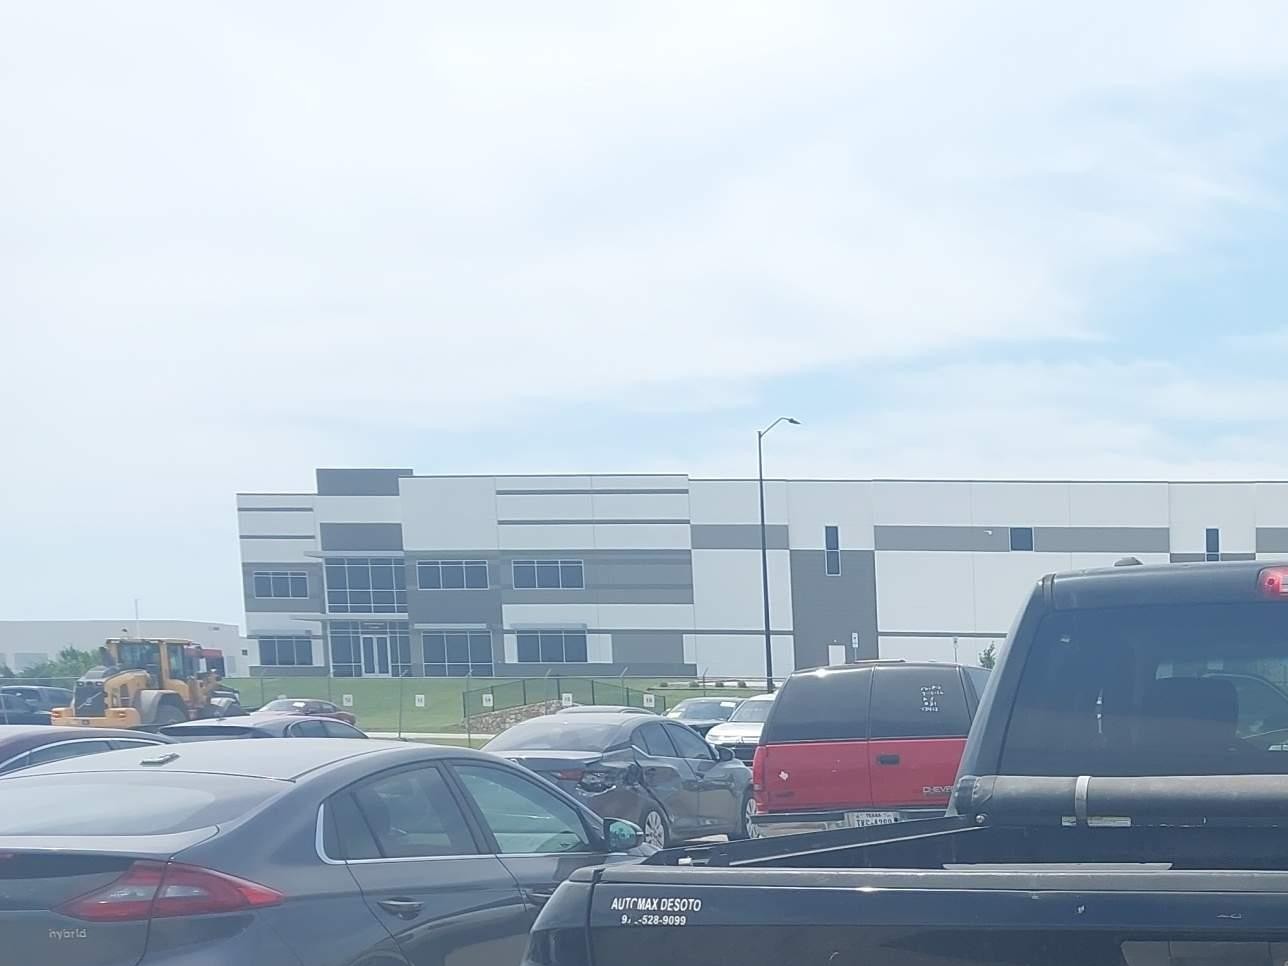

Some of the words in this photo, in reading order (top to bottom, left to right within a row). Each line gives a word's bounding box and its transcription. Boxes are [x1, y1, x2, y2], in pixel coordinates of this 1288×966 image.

[660, 898, 702, 911] DESOTO
[621, 914, 686, 926] 9-528-9099
[48, 928, 88, 940] hybrid
